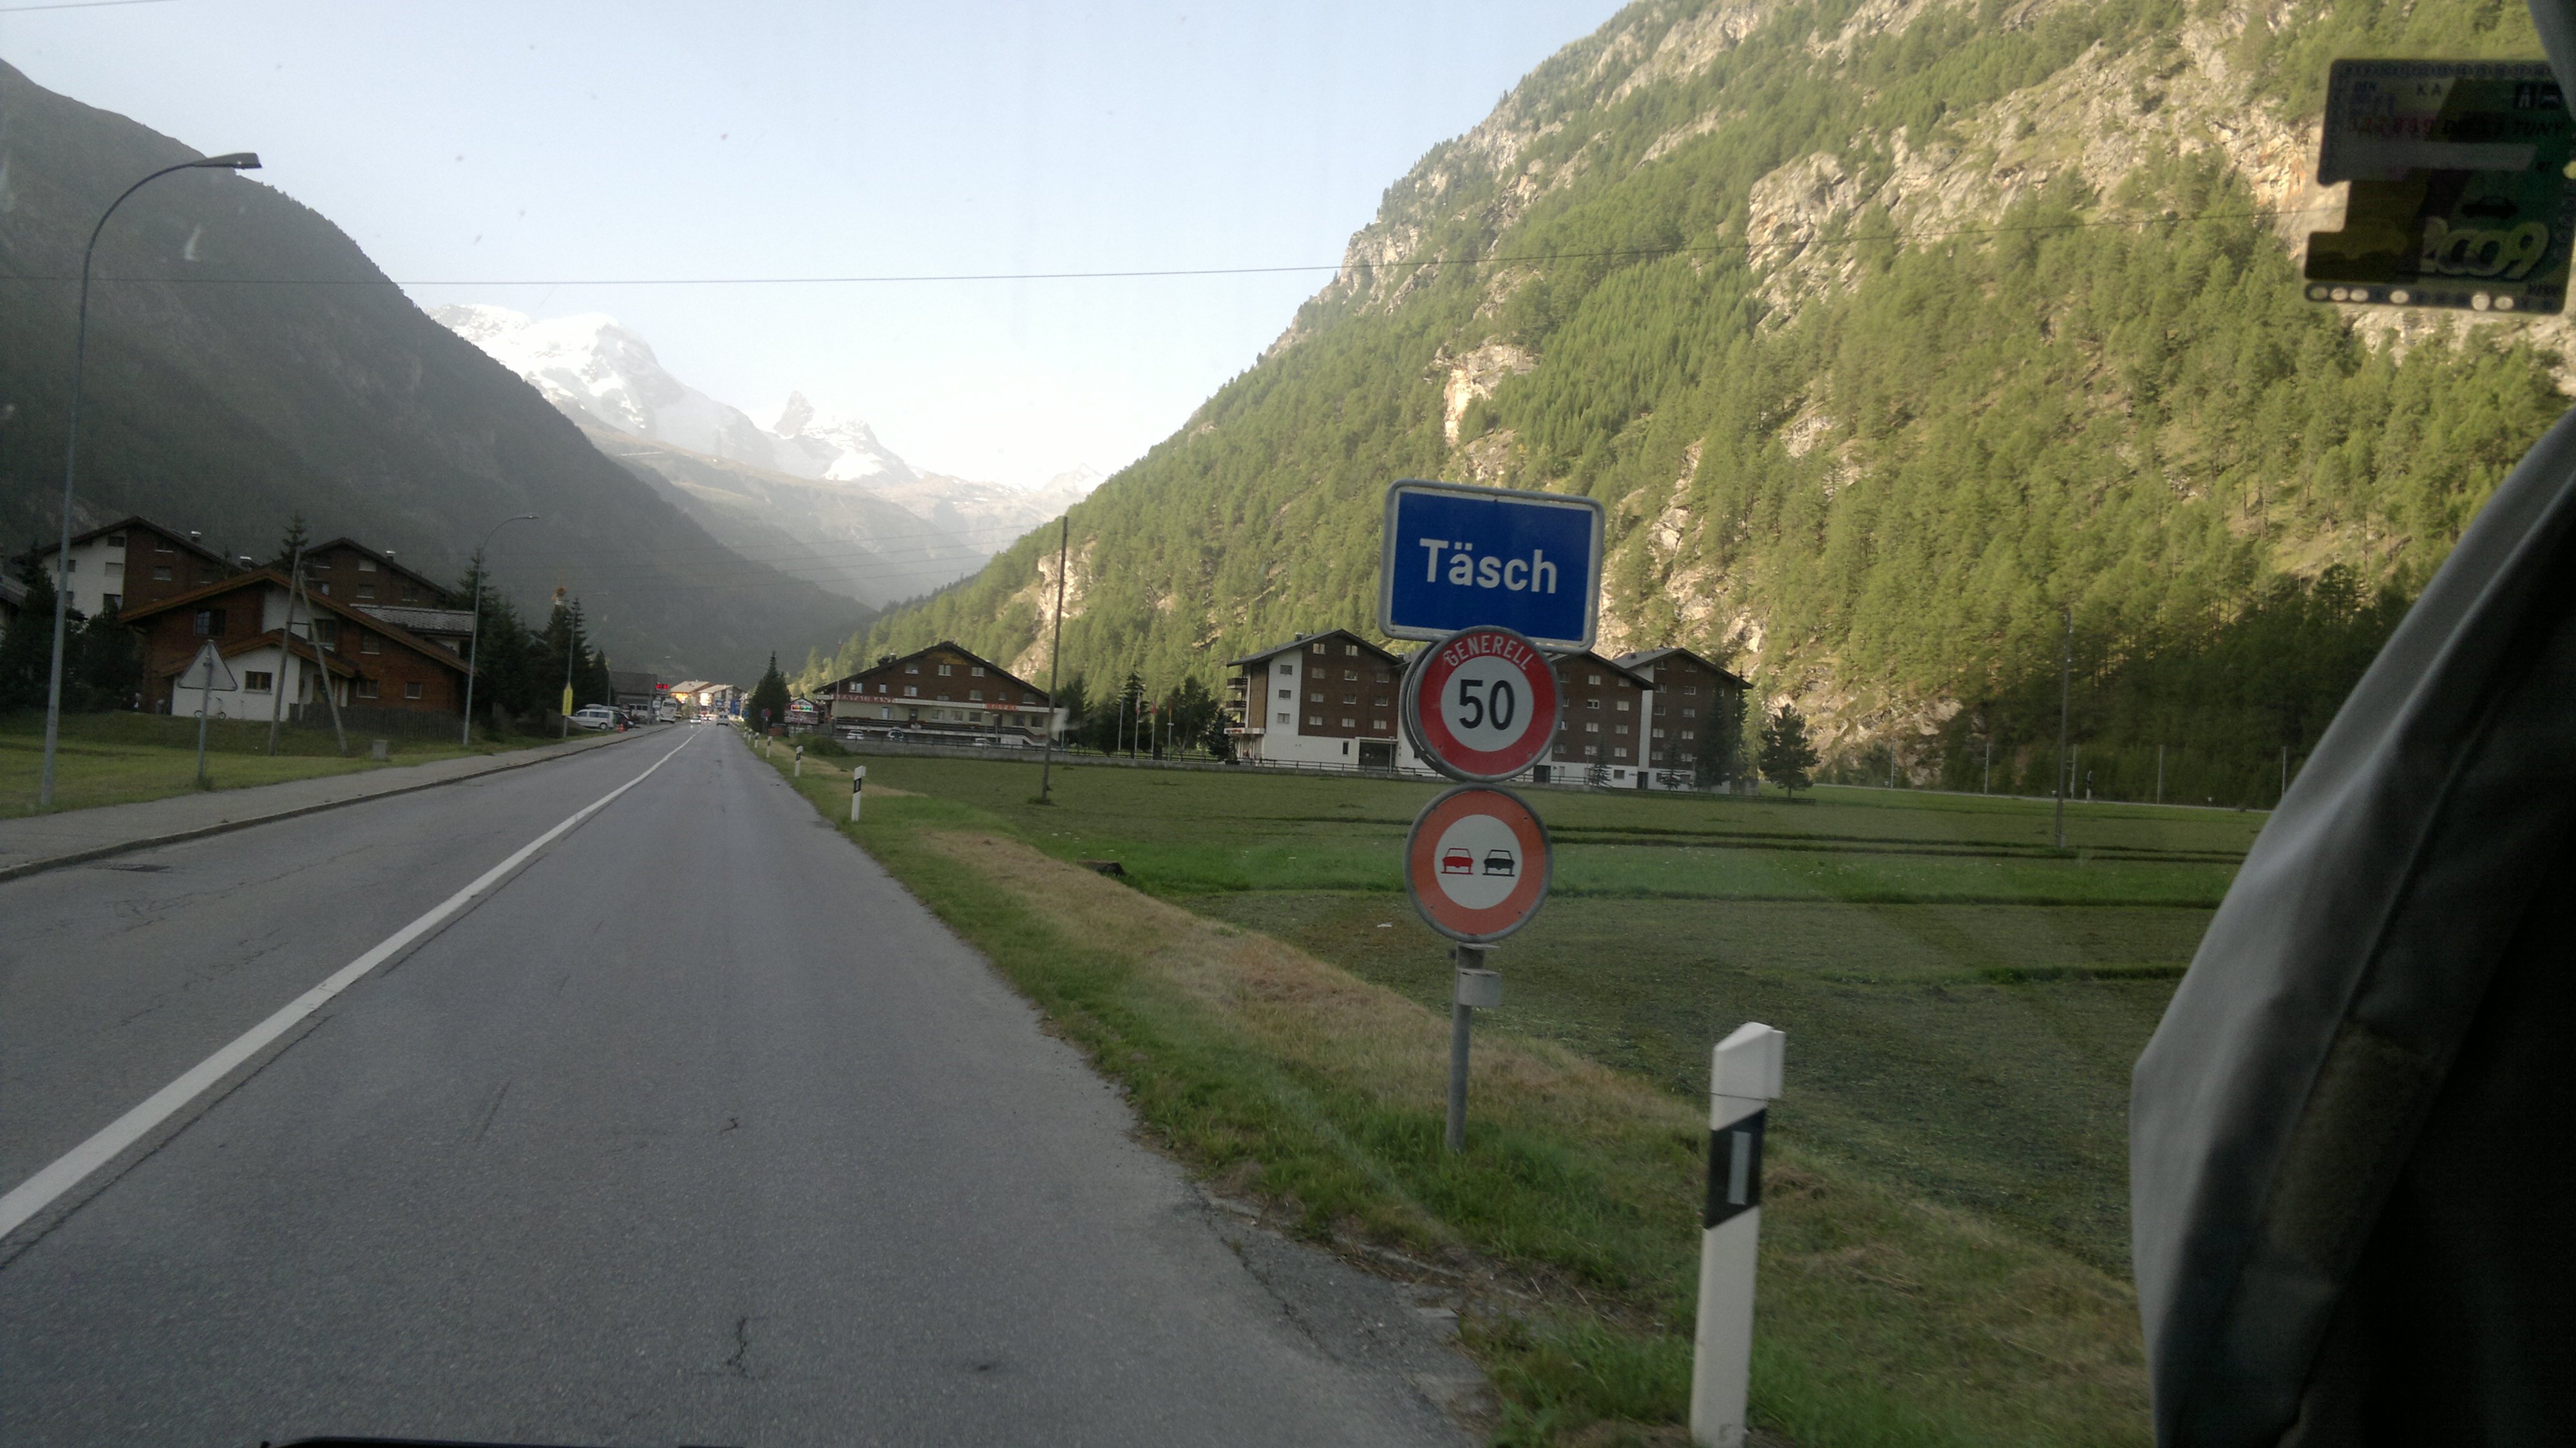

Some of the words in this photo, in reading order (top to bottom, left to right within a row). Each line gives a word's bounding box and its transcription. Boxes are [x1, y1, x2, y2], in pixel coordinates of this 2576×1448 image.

[1419, 537, 1558, 595] Täsch
[1443, 634, 1534, 671] GENERELL
[1459, 679, 1515, 730] 50
